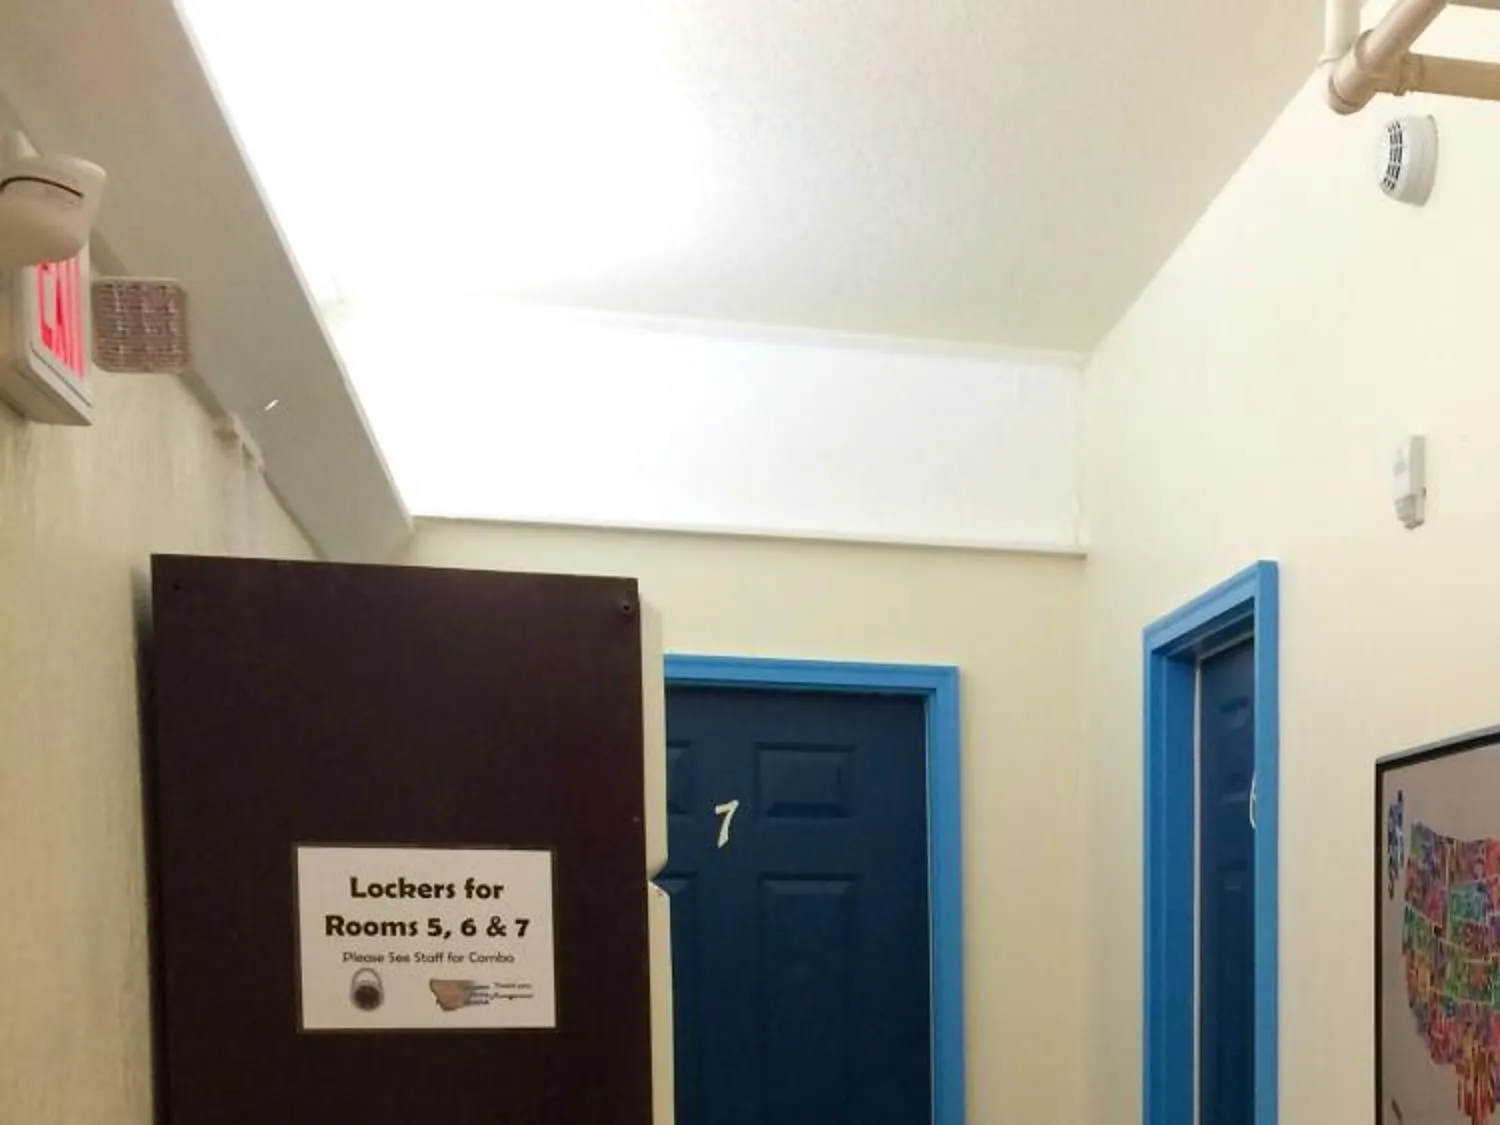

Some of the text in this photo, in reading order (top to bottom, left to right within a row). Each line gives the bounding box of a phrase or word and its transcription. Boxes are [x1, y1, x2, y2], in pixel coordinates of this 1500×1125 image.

[715, 799, 740, 849] 7
[350, 876, 505, 899] Lockers for
[324, 915, 531, 939] Rooms 5, 6 & 7
[342, 951, 516, 964] Please See Staff for Combo
